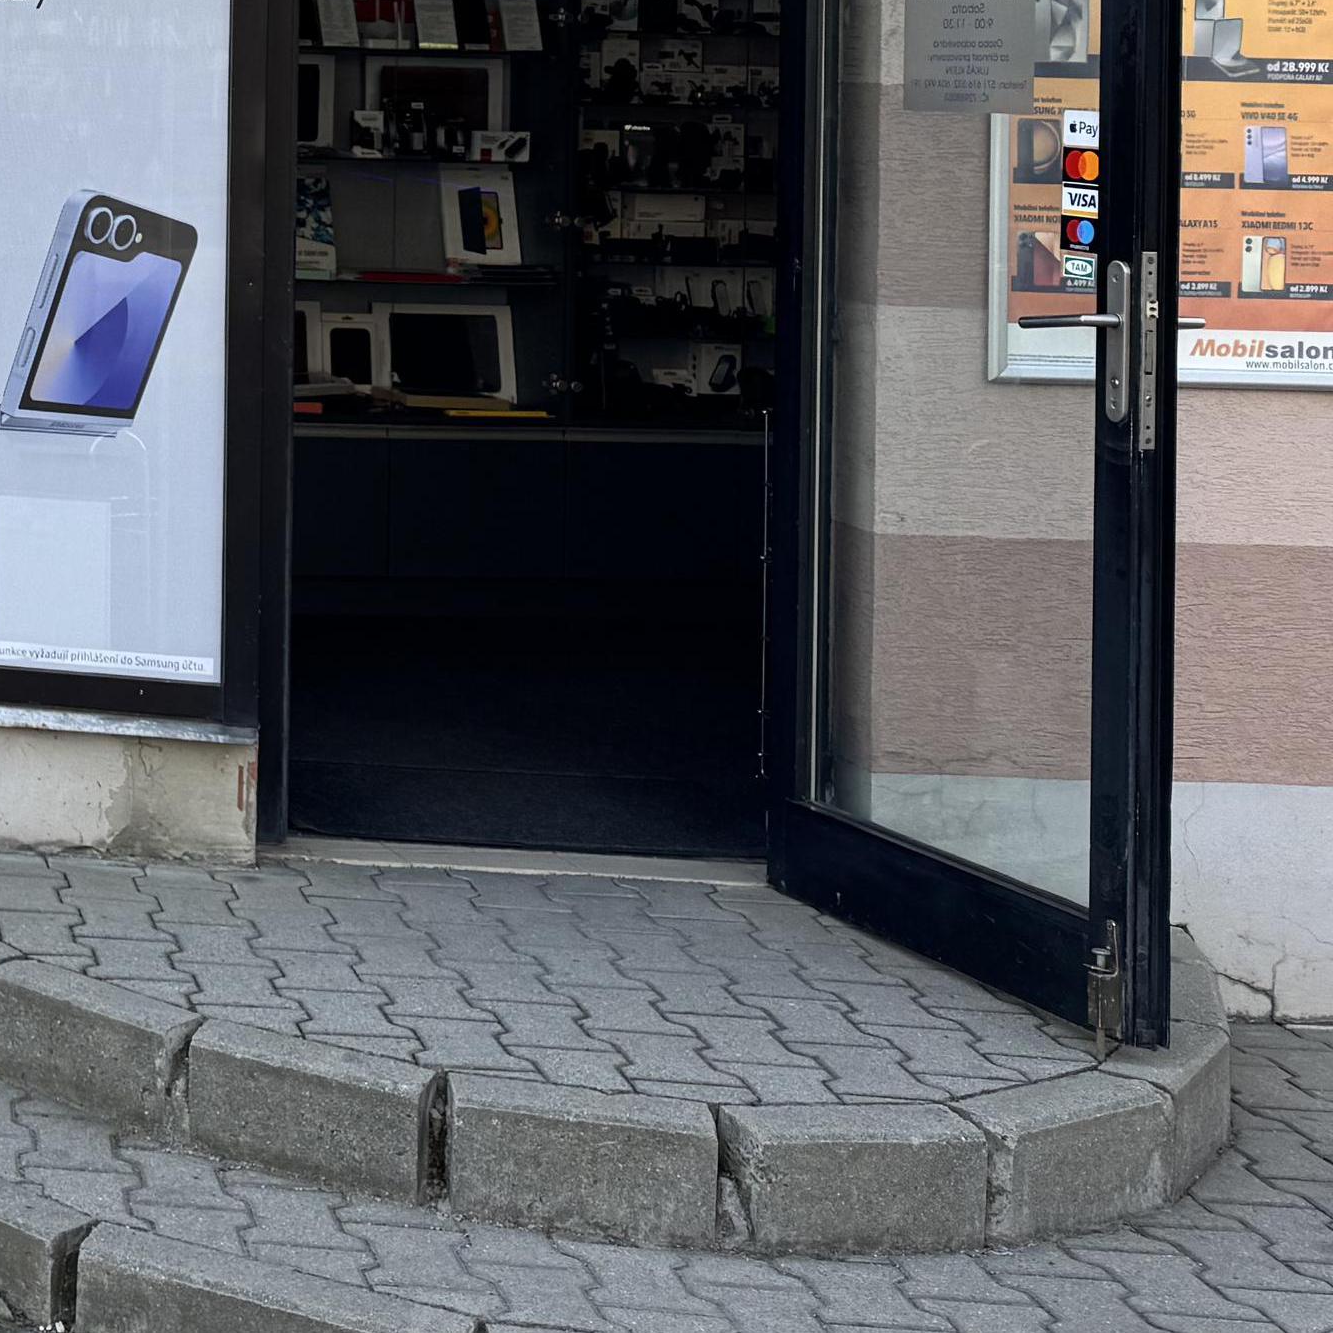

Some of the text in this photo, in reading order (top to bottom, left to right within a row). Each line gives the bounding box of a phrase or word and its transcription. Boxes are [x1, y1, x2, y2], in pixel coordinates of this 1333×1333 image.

[1267, 61, 1330, 73] od 28.999 Kč
[1079, 121, 1098, 137] Pay
[1068, 192, 1097, 208] VISA
[1180, 219, 1202, 227] ALAXY
[1190, 339, 1333, 360] Mobilsalon
[135, 656, 180, 672] Samsung
